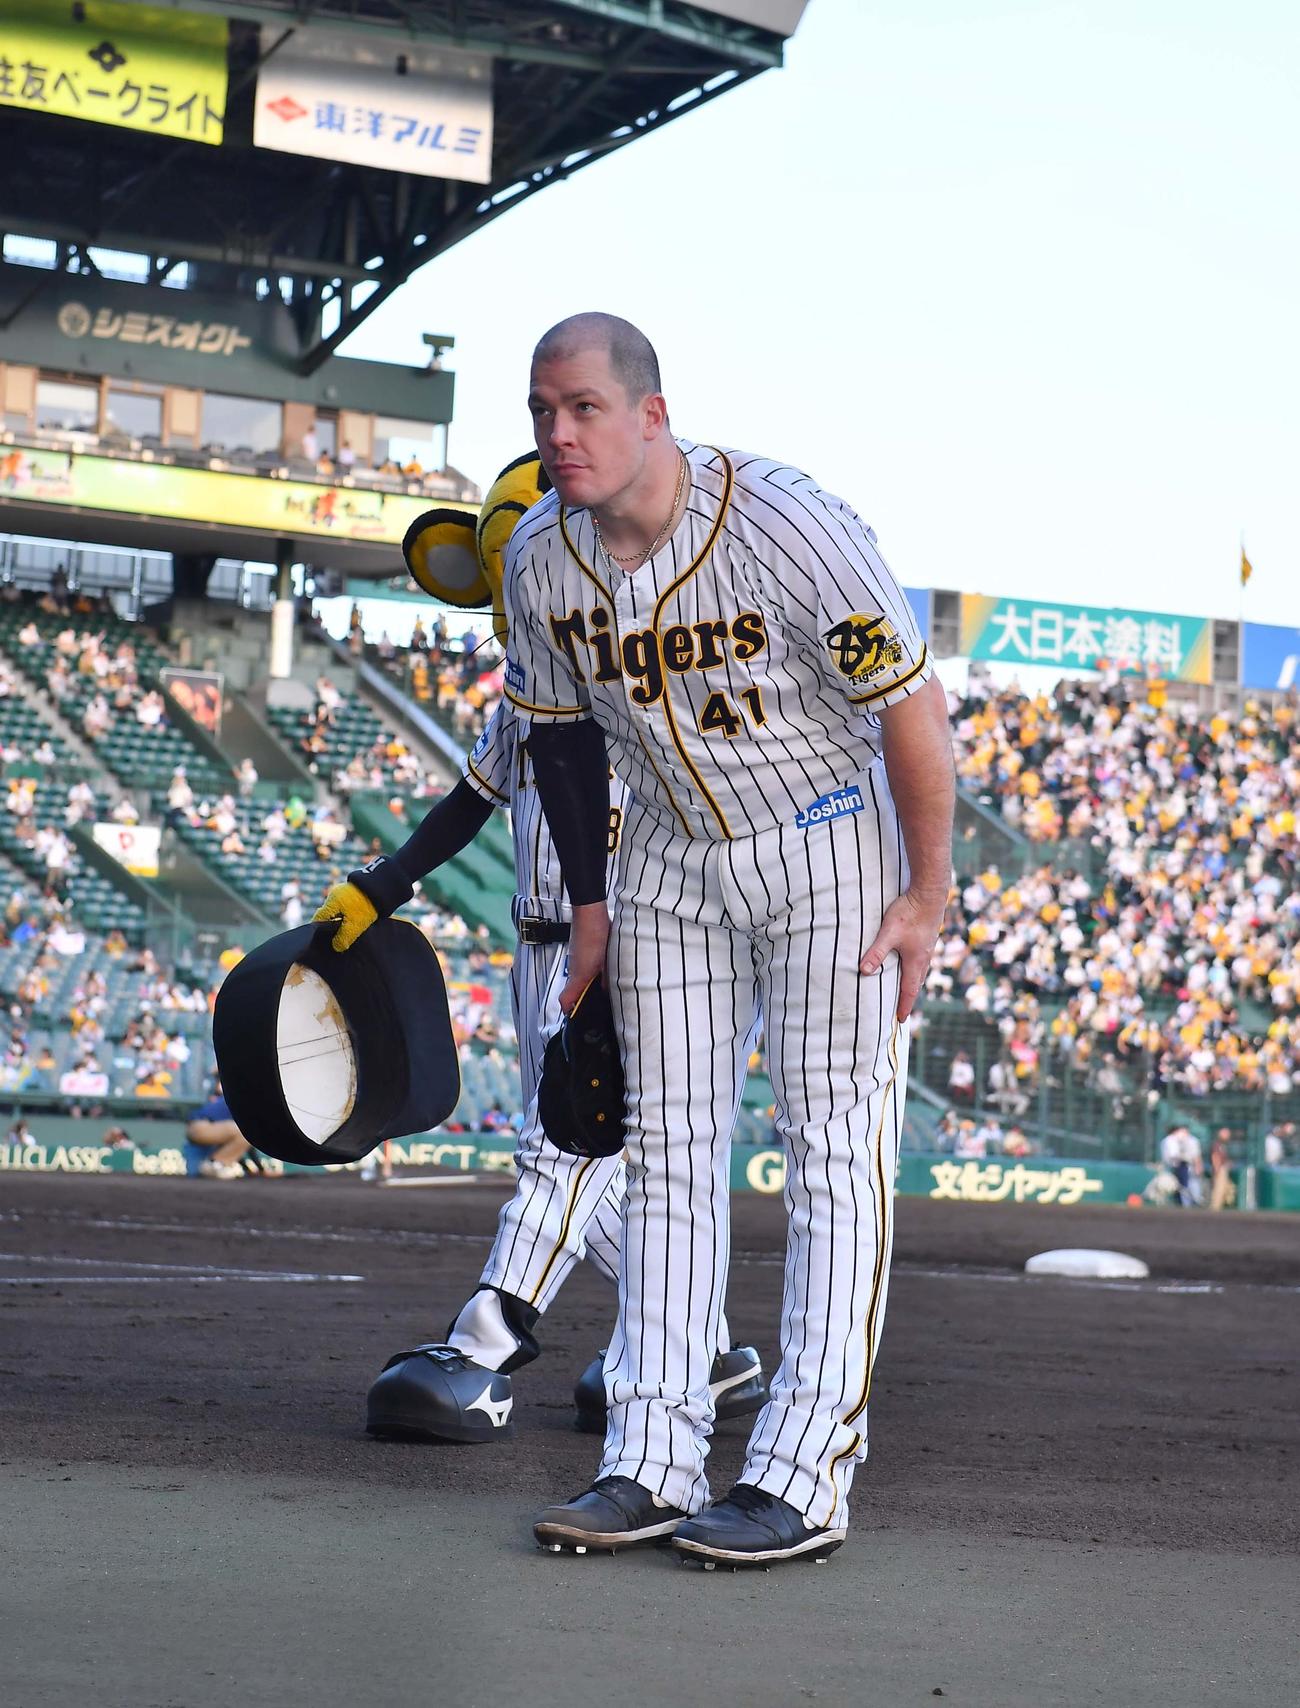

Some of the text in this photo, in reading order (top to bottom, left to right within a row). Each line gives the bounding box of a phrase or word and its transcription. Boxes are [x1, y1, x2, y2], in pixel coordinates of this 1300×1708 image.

[316, 102, 481, 154] 東洋アルミ
[92, 303, 251, 355] シミズオクト
[550, 607, 765, 706] Tigers
[821, 616, 885, 676] 85
[990, 605, 1181, 673] 大日本塗料
[849, 664, 886, 686] Tigers
[701, 687, 768, 738] 41
[798, 791, 862, 824] Joshin
[0, 1144, 113, 1173] LLCLASSIC
[930, 1161, 1103, 1204] 文化シャッター
